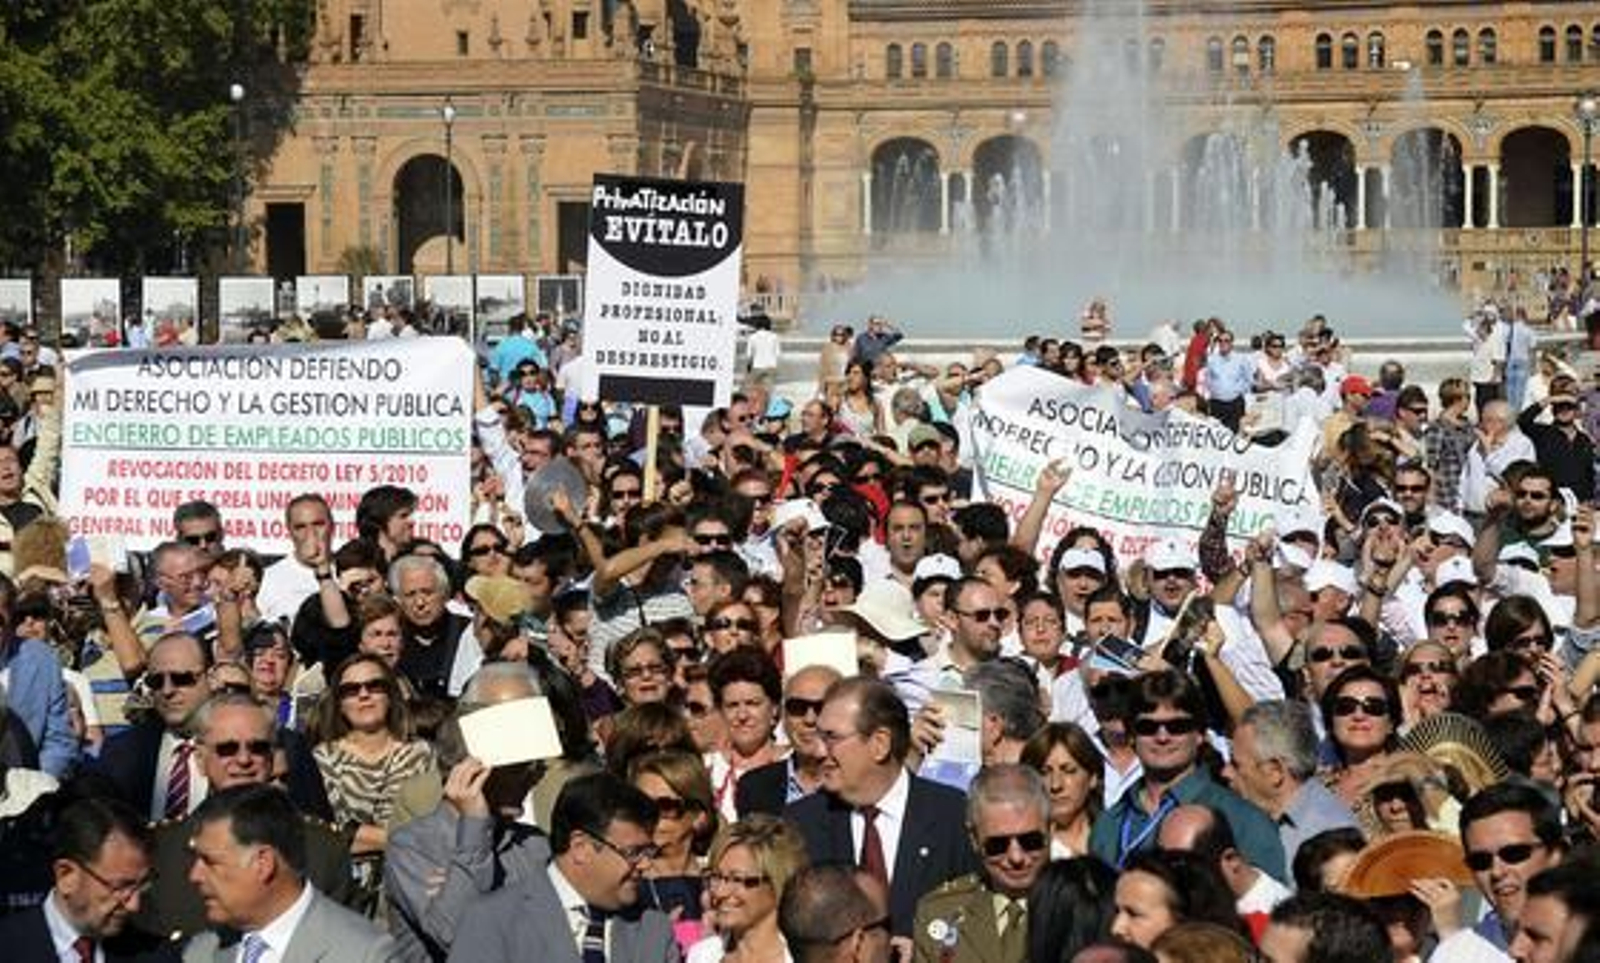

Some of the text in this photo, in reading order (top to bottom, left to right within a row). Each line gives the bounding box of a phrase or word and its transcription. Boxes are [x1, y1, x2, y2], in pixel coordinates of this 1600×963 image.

[603, 213, 729, 248] EVÍTALO
[621, 281, 706, 300] DIGNIDAD
[638, 330, 684, 345] NO AL
[289, 357, 403, 381] DEFIENDO
[73, 388, 99, 411] MI
[106, 388, 211, 414] DERECHO
[218, 391, 232, 413] Y
[238, 391, 265, 415] LA
[72, 420, 180, 445] ENCIERRO
[188, 424, 217, 446] DE
[224, 424, 351, 449] EMPLEADOS
[223, 461, 253, 481] DEL
[258, 461, 329, 482] DECRETO
[335, 464, 363, 482] LEY
[369, 464, 429, 484] 5/2010
[1105, 452, 1122, 477] Y
[1121, 458, 1148, 487] LA
[83, 486, 119, 507] POR
[124, 487, 142, 508] EL
[147, 489, 183, 509] QUE
[69, 516, 144, 537] GENERAL
[222, 519, 258, 539] ARA
